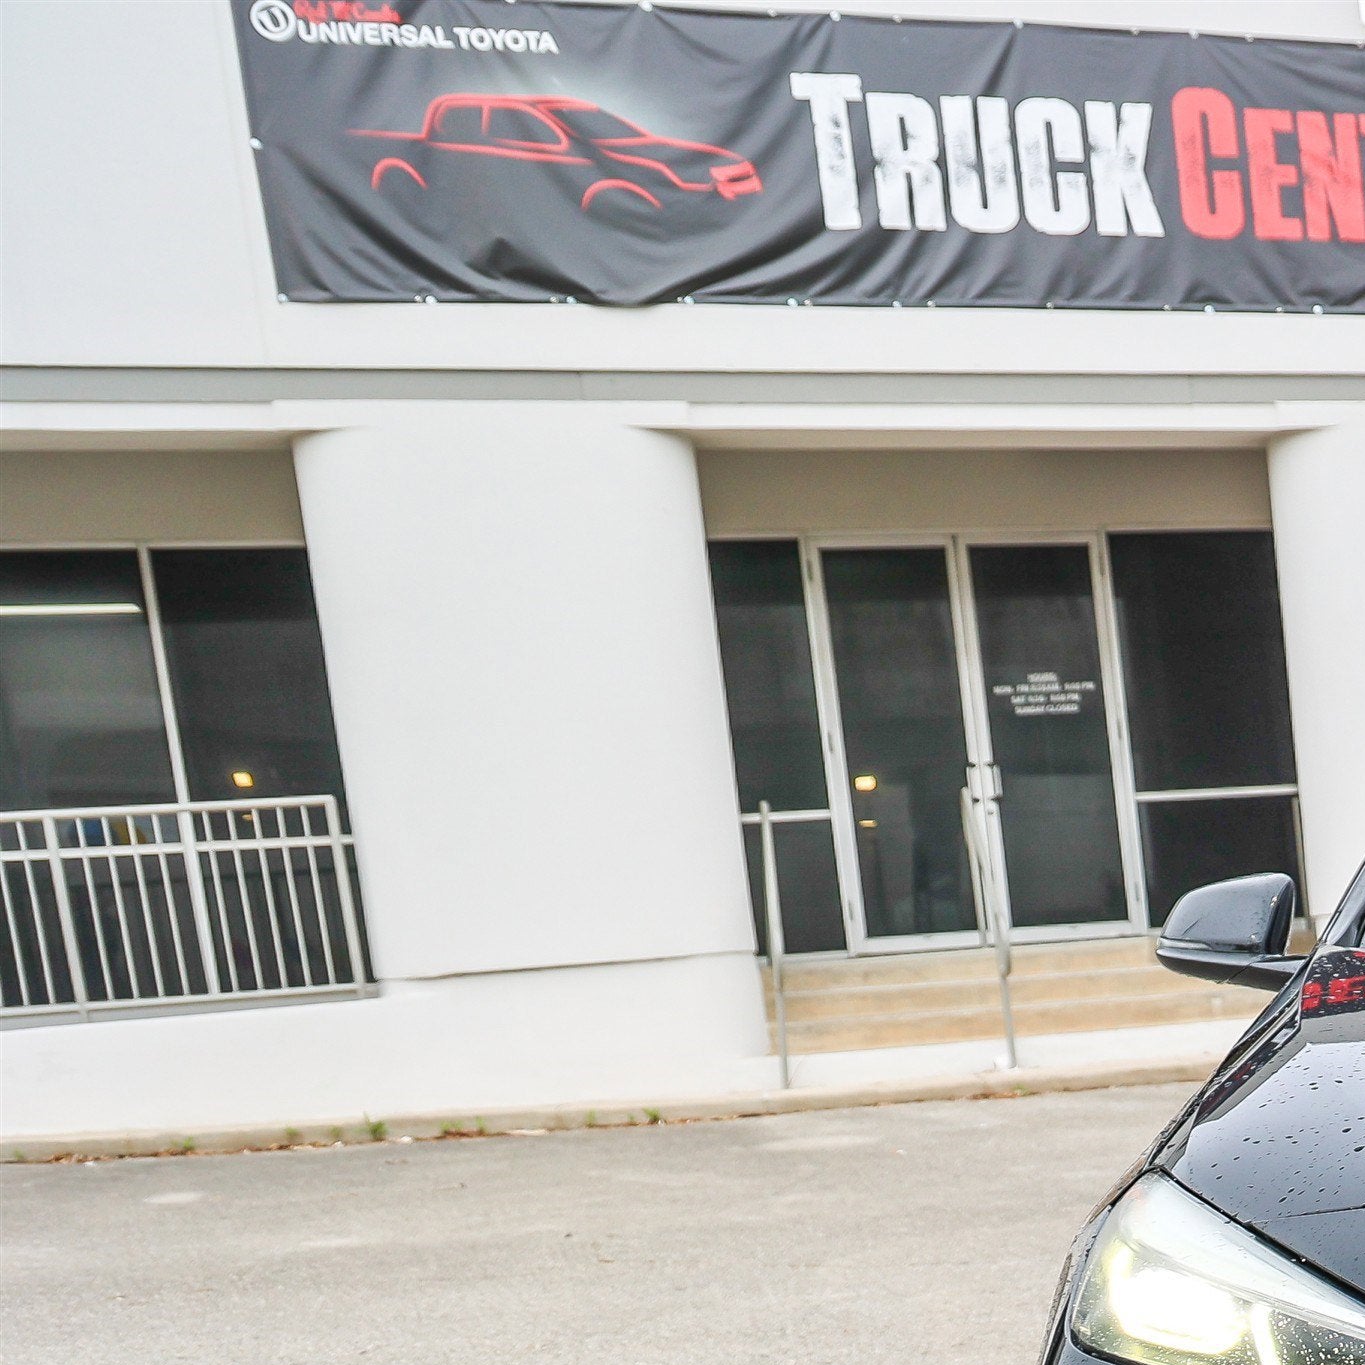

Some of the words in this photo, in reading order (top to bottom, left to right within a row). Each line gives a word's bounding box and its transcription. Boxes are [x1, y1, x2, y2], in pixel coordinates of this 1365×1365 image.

[297, 19, 456, 49] UNIVERSAL
[452, 26, 559, 55] TOYOTA
[790, 71, 1166, 238] TRUCK
